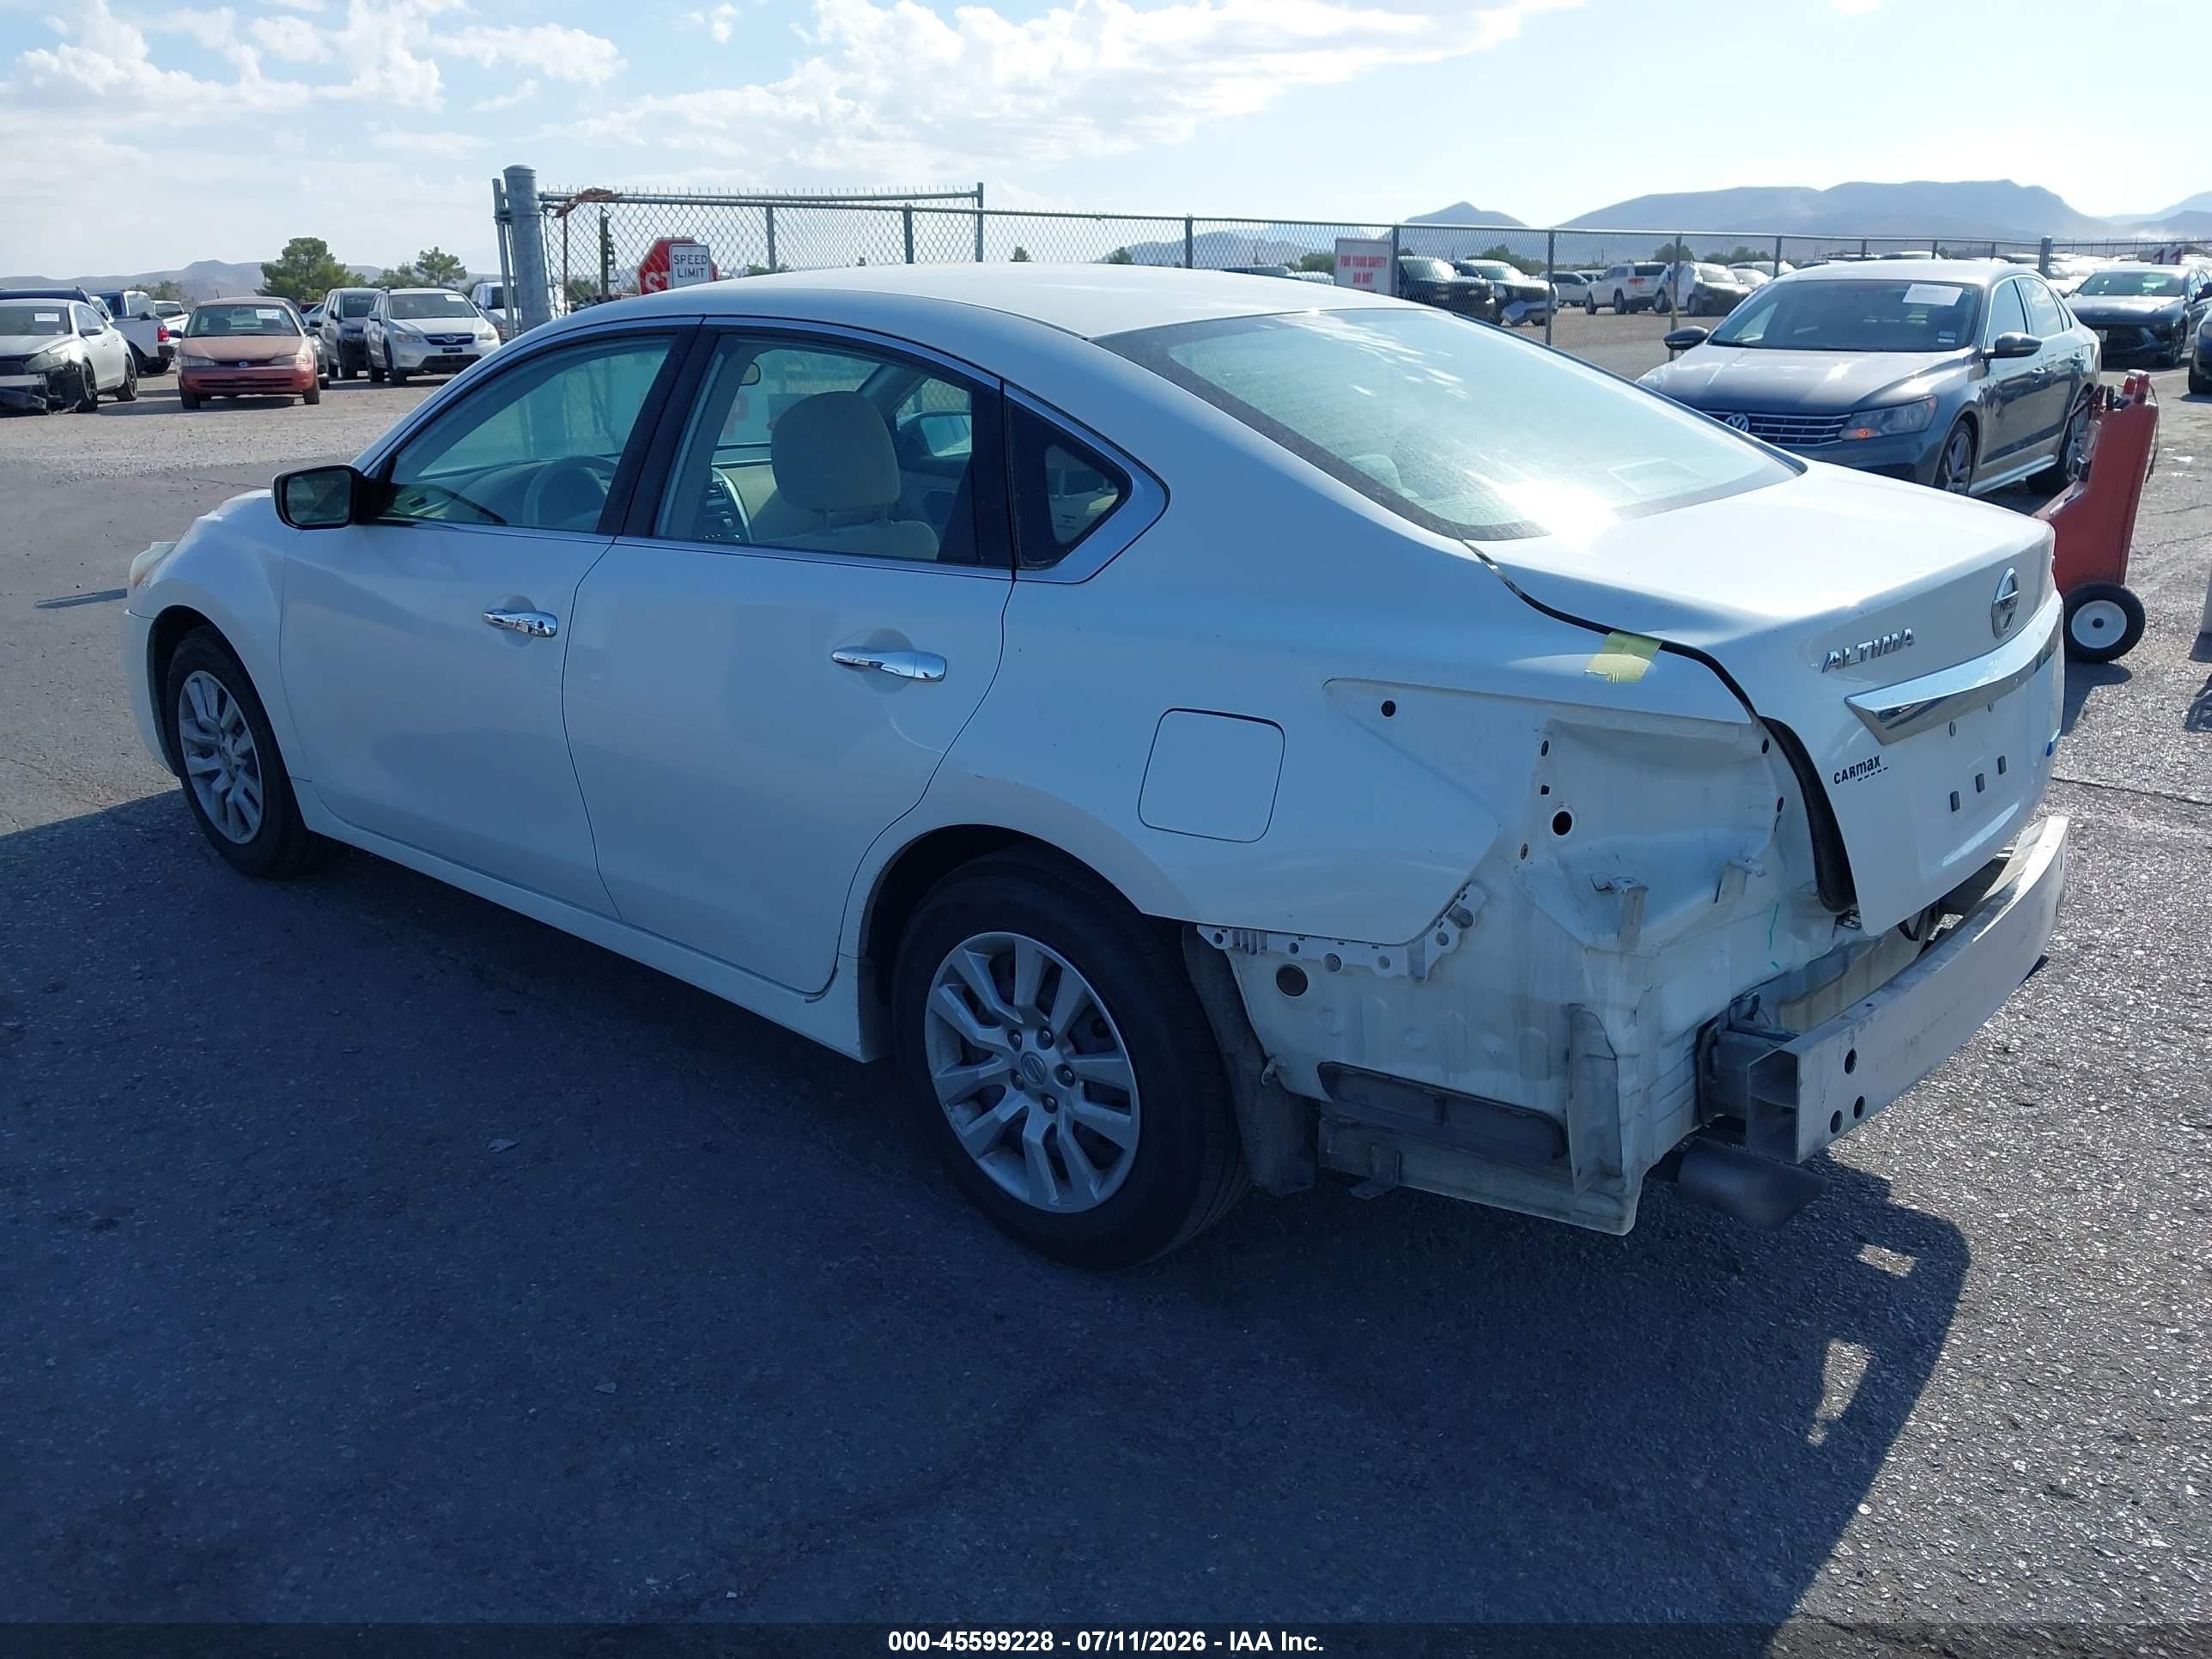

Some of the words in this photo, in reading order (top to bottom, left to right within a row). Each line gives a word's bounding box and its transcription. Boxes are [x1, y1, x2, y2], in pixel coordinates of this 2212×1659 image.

[673, 254, 708, 265] SPEED
[1340, 255, 1352, 268] FOR
[1352, 256, 1367, 268] YOUR
[1368, 256, 1388, 268] SAFETY
[677, 267, 706, 278] LIMIT
[1352, 272, 1361, 283] DO
[1362, 272, 1374, 283] NOT
[1821, 628, 1916, 673] ALTIMA
